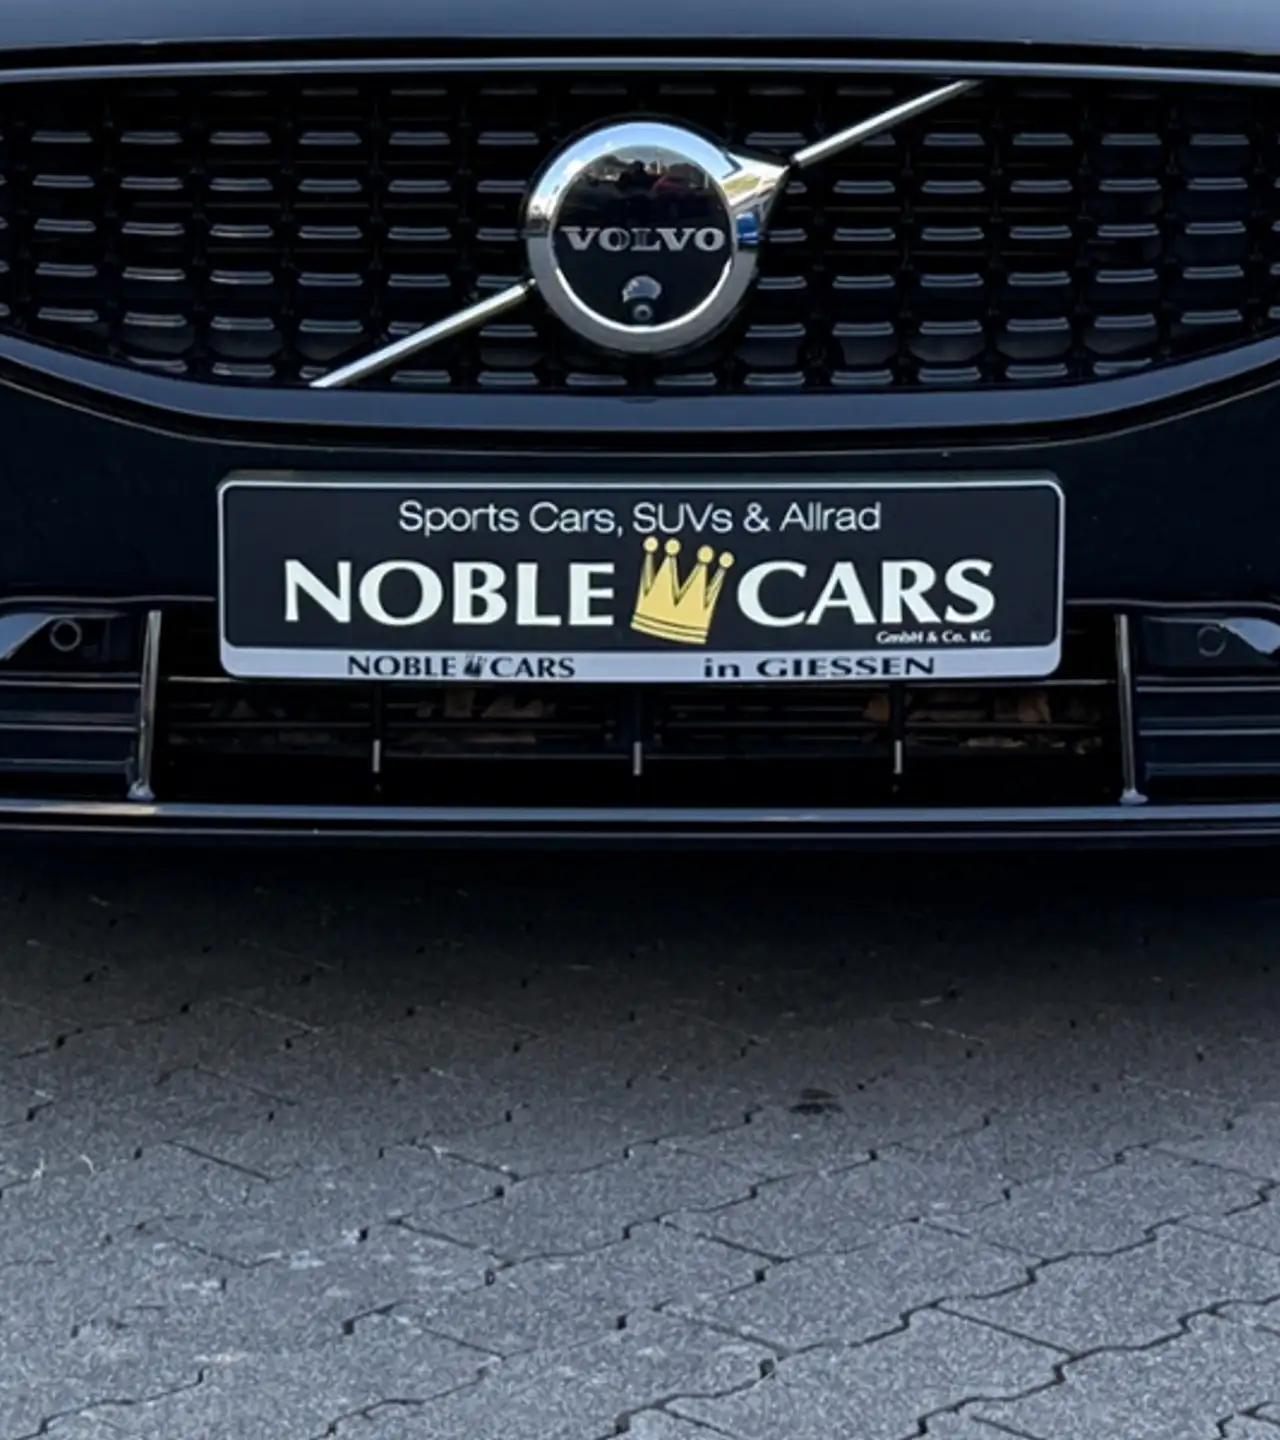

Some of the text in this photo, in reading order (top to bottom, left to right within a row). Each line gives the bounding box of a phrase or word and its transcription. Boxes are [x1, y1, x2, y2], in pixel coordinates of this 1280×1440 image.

[562, 226, 726, 252] VOLVO
[398, 499, 882, 537] Sports Cars, SUVs & Allrad
[284, 559, 996, 627] NOBLE CARS
[875, 629, 992, 644] GmbH & Co. KG
[347, 655, 935, 679] NOBLE CARS in GIESSEN
